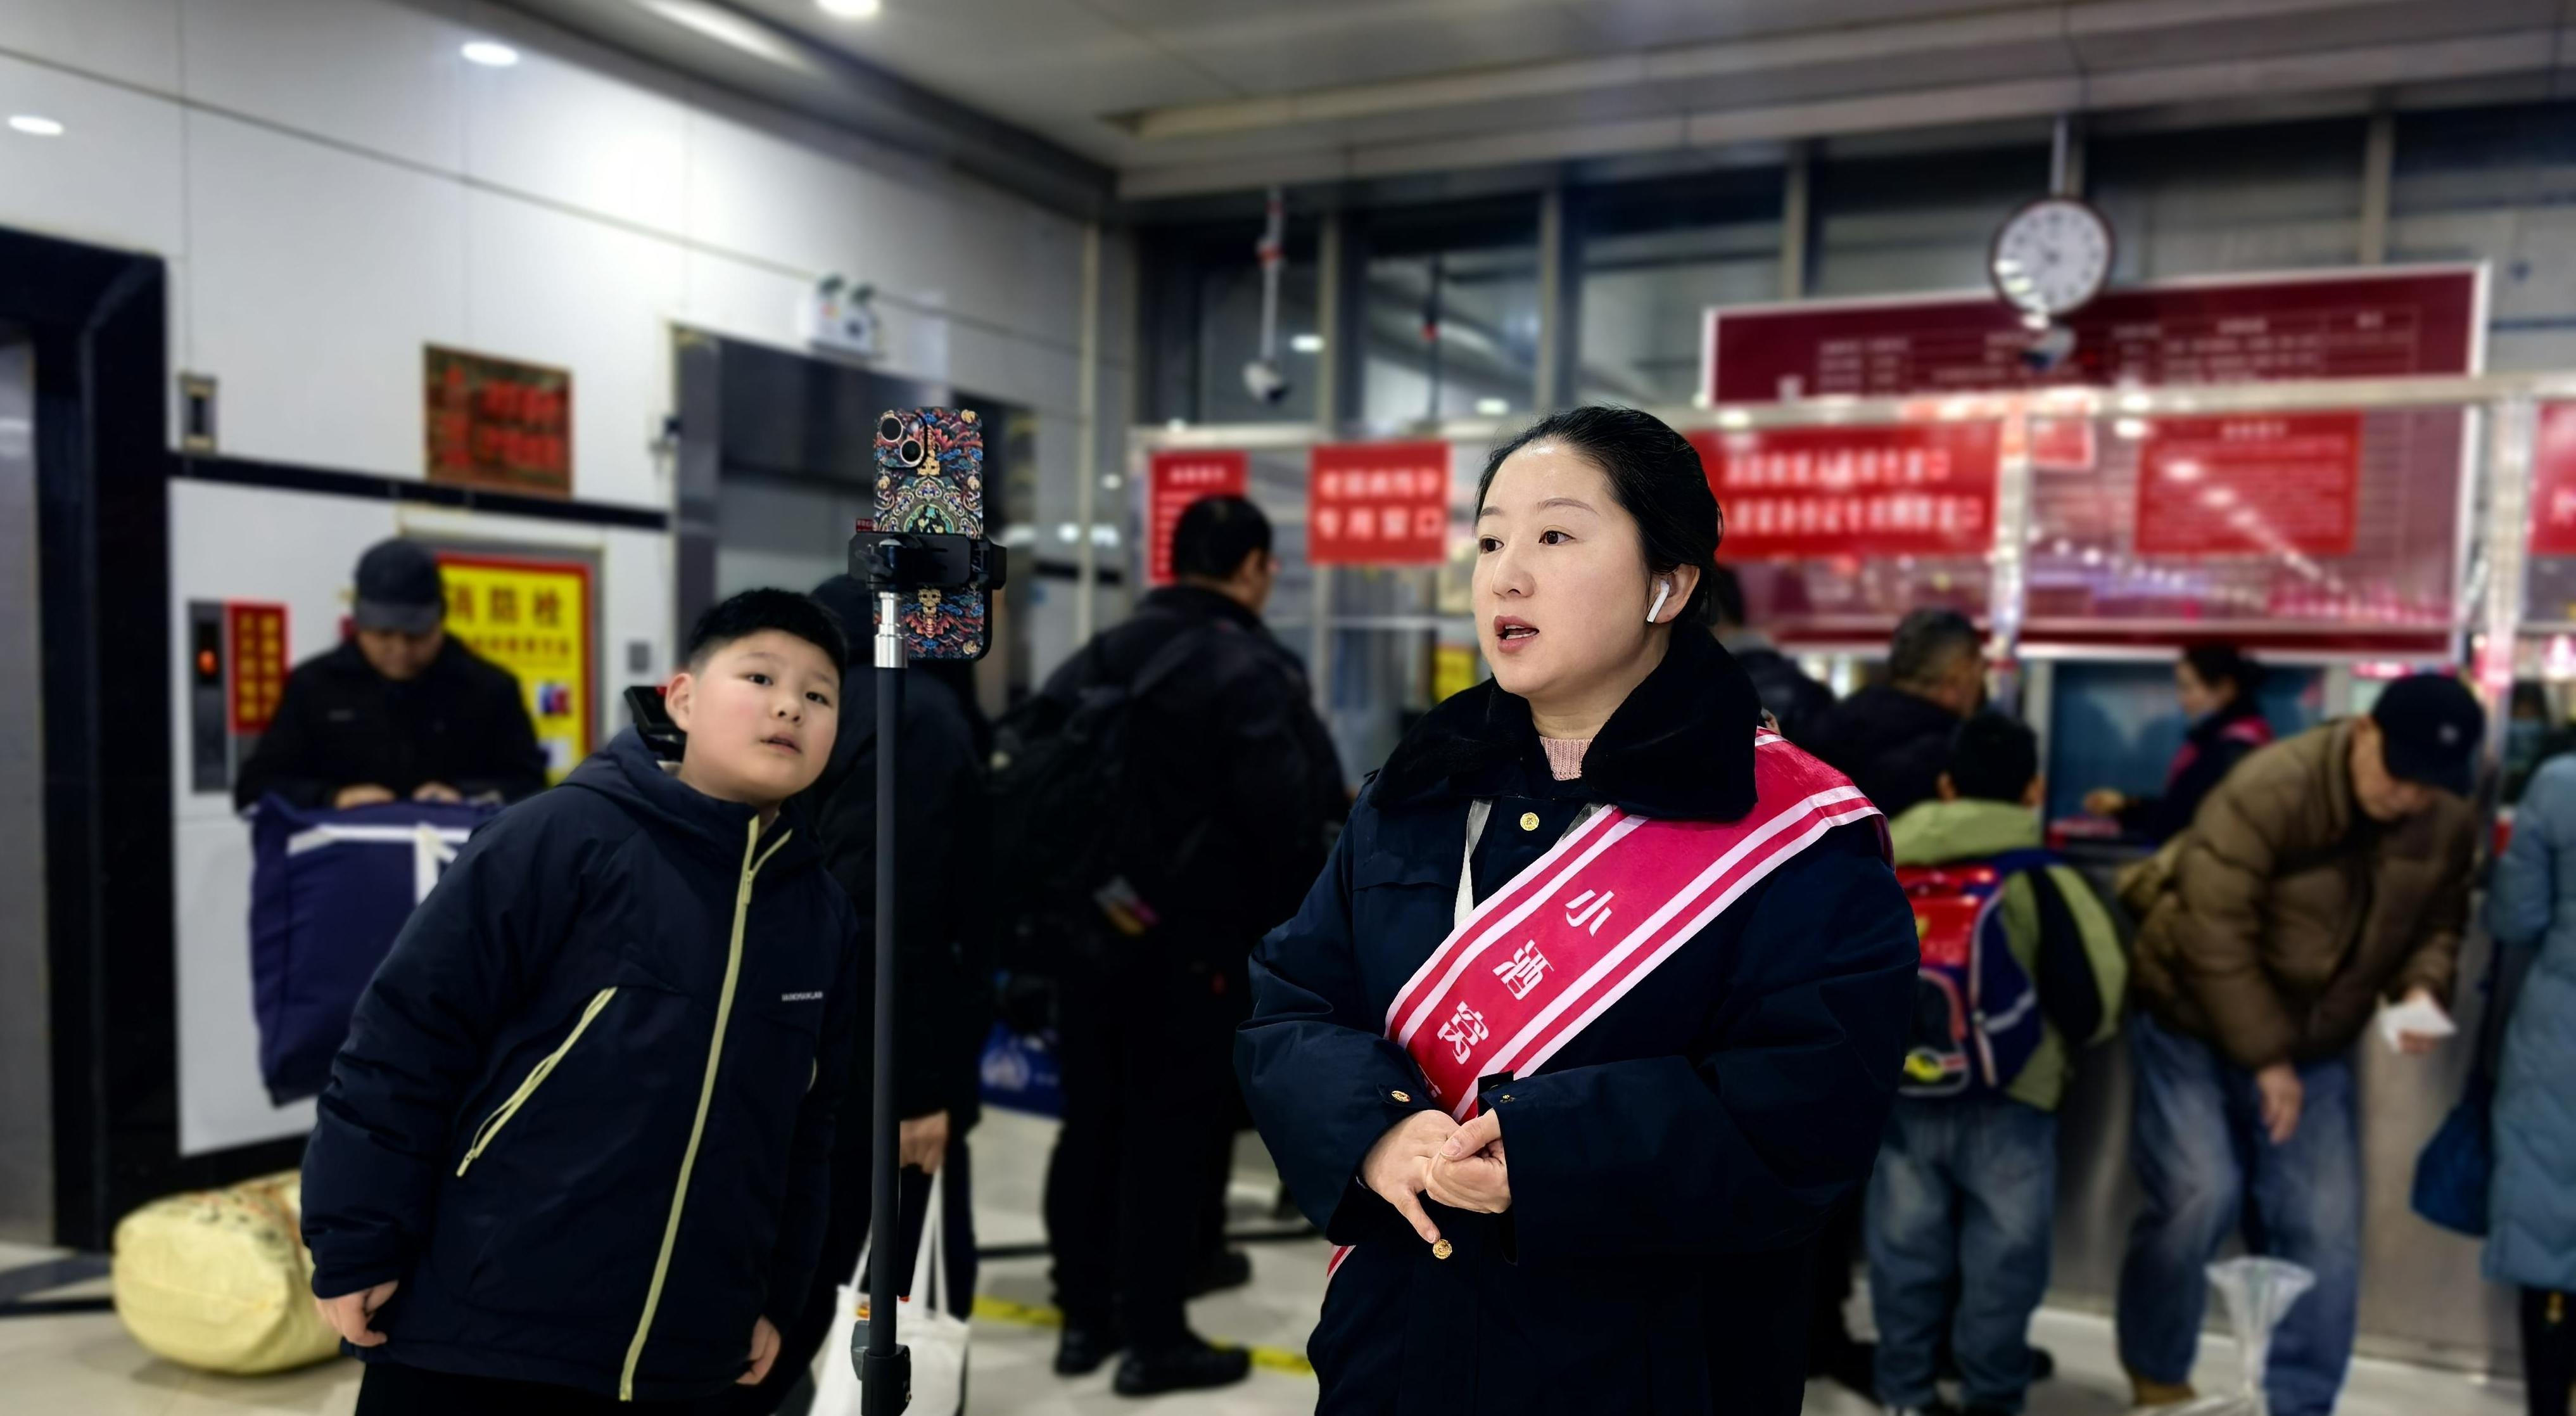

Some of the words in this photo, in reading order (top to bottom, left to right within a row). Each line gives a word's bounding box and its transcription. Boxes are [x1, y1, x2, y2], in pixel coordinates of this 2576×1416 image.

[1316, 506, 1445, 539] 专用窗口
[1418, 889, 1615, 1098] 小酒窝
